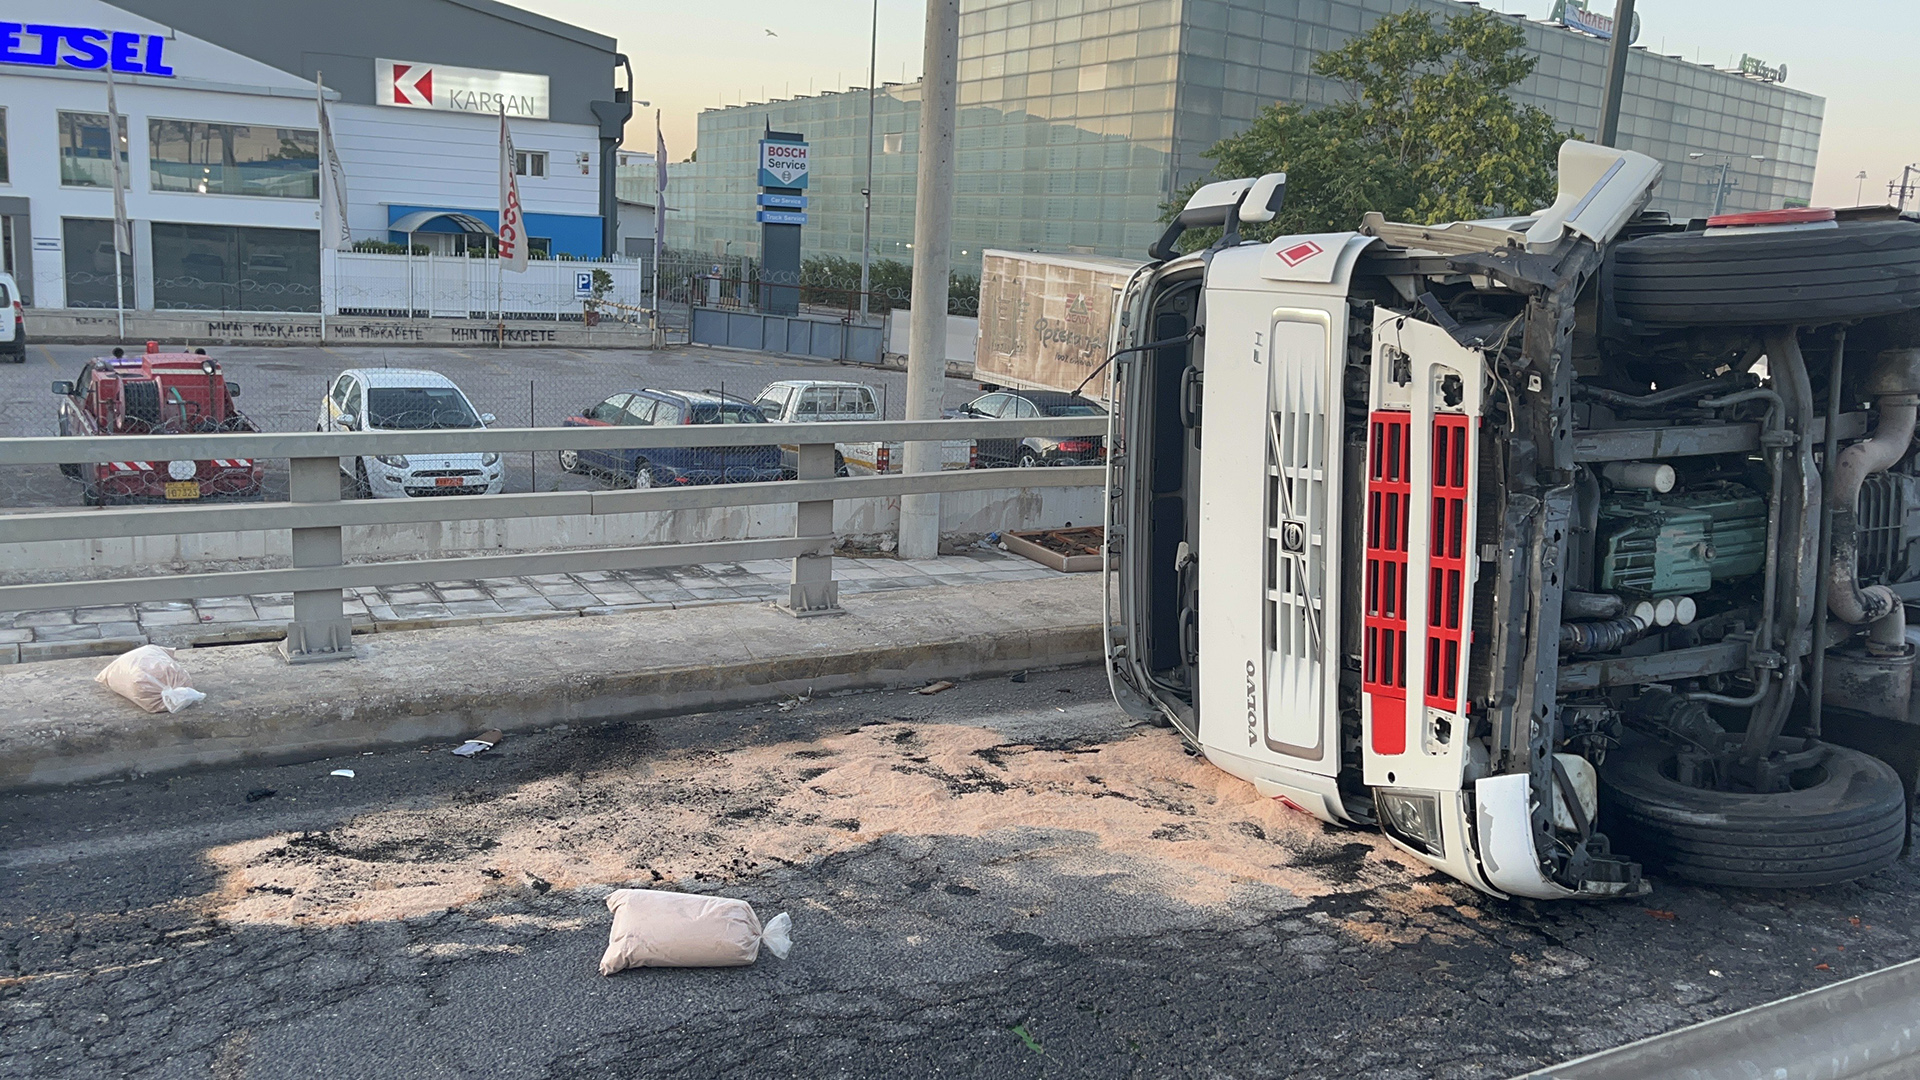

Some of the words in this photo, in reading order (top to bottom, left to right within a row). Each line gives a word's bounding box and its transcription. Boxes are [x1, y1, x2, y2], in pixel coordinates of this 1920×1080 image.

[1579, 10, 1613, 31] ΠΩΛΕΙΤ
[450, 89, 534, 116] KARSAN
[768, 146, 806, 158] BOSCH
[768, 158, 806, 170] Service
[579, 274, 589, 289] P
[1246, 660, 1258, 747] VOLVO
